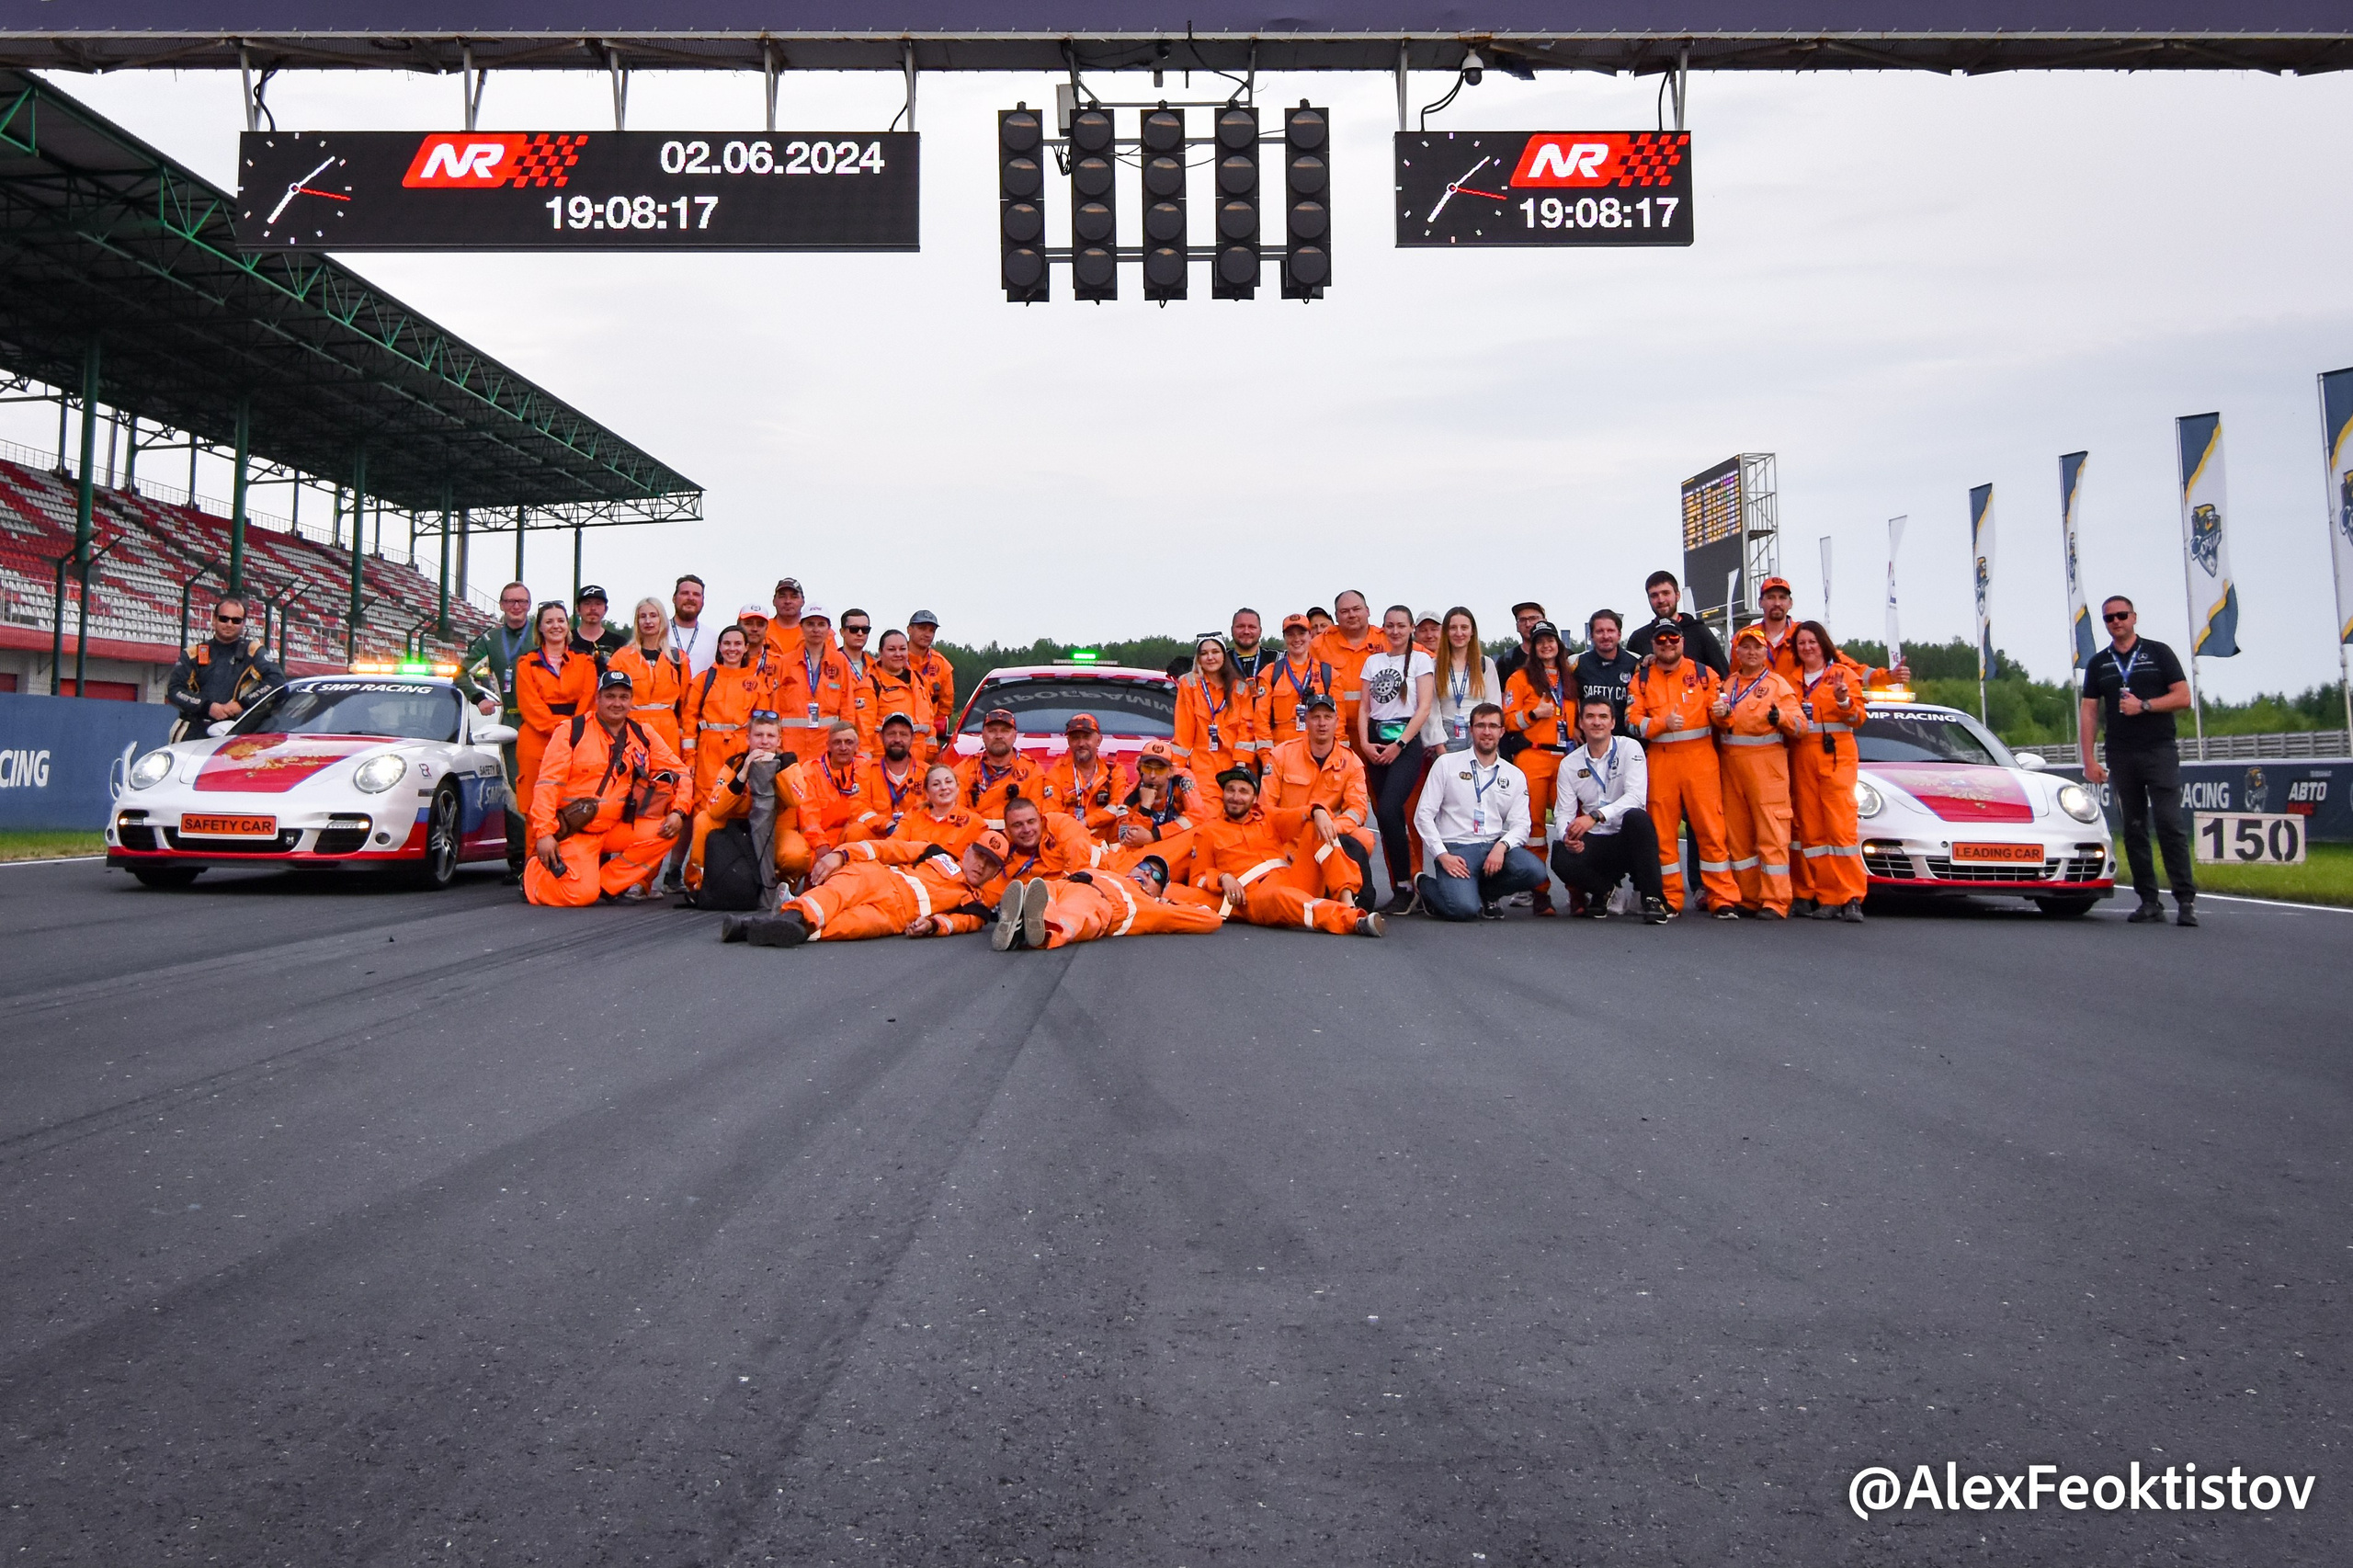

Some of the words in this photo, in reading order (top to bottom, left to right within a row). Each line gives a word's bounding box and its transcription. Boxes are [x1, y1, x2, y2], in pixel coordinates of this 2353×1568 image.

[420, 143, 505, 178] NR
[661, 142, 885, 175] 02.06.2024
[1528, 143, 1608, 177] NR
[546, 195, 719, 229] 19:08:17
[1519, 198, 1678, 228] 19:08:17
[318, 683, 359, 691] SMP
[359, 684, 434, 694] RACING
[1893, 712, 1957, 722] RACING
[2180, 782, 2230, 809] ACING
[2288, 781, 2328, 801] АВТО
[184, 818, 238, 831] SAFETY
[242, 820, 272, 832] CAR
[1955, 846, 2011, 858] LEADING
[2015, 847, 2040, 858] CAR
[2202, 818, 2299, 862] 150
